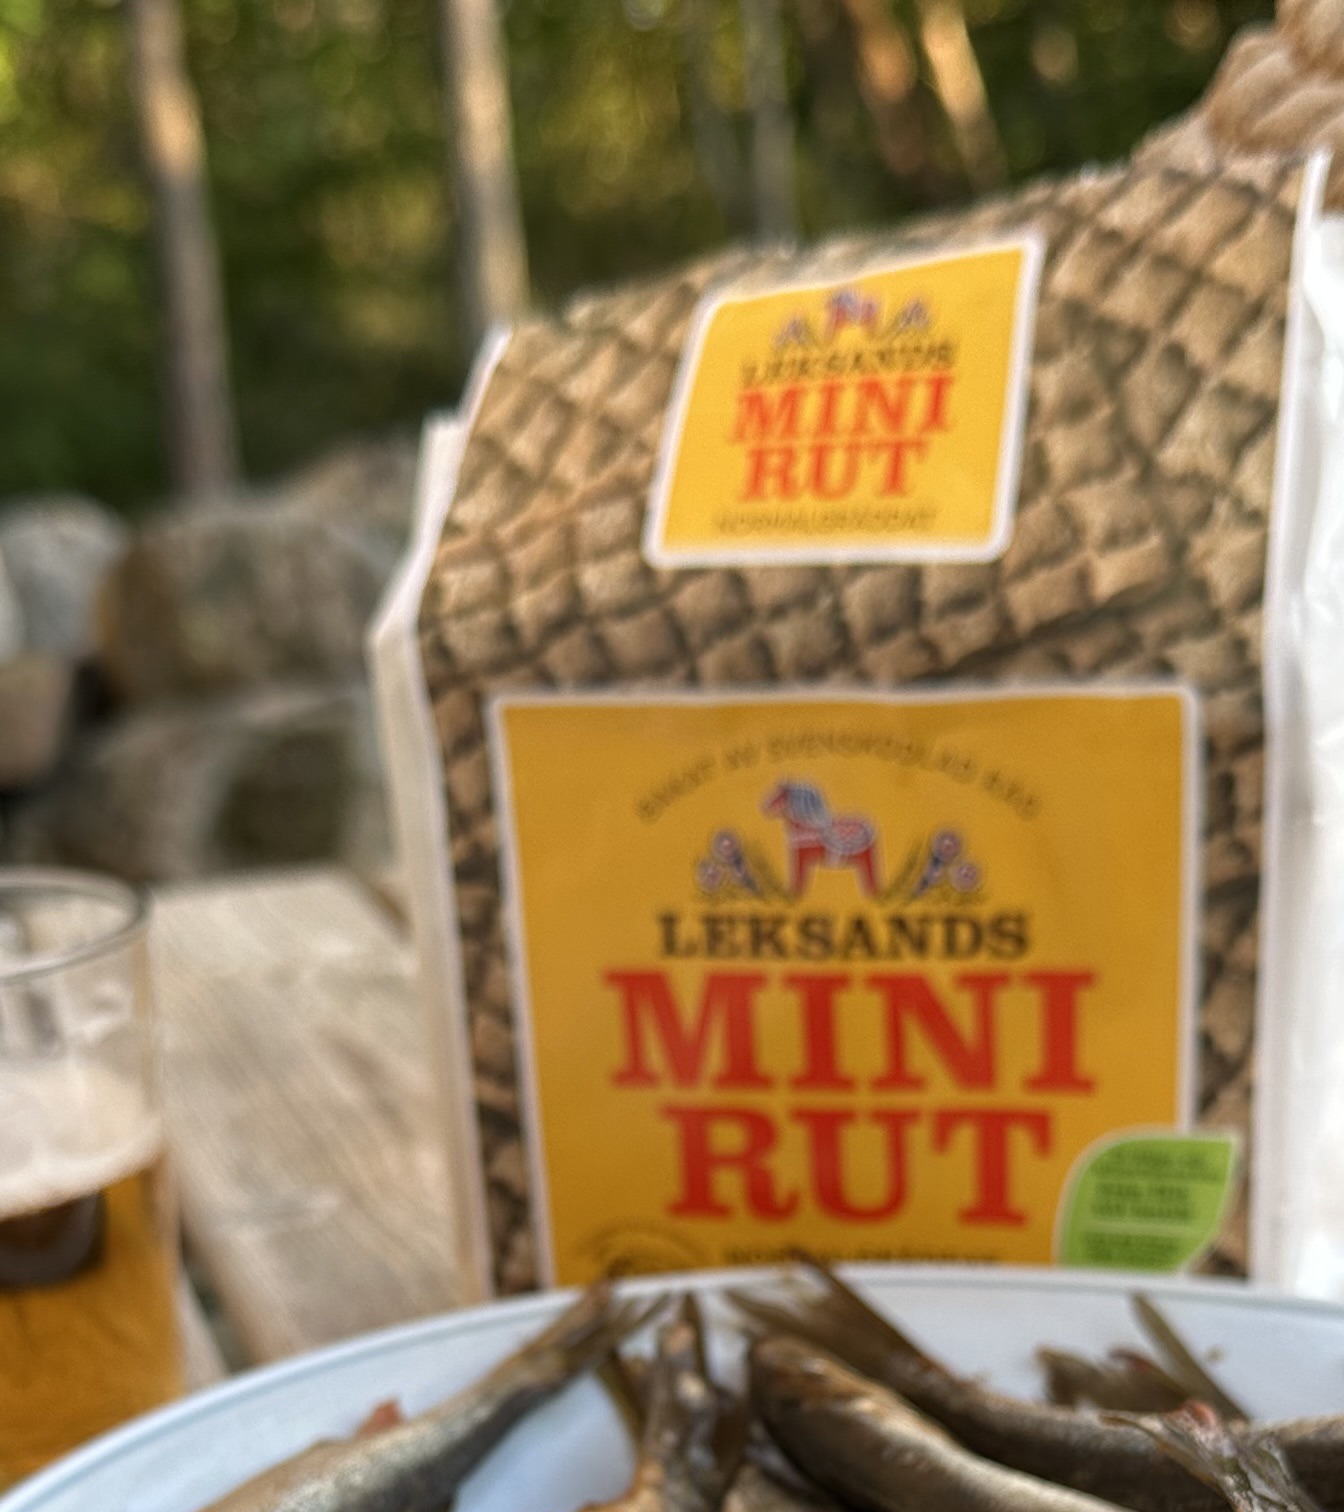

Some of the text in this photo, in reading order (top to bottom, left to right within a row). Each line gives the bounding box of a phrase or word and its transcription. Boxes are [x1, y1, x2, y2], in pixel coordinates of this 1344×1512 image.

[732, 371, 955, 446] MINI
[742, 438, 930, 501] RUT
[656, 911, 1033, 960] LEKSANDS
[605, 970, 1099, 1096] MINI
[662, 1106, 1054, 1227] RUT
